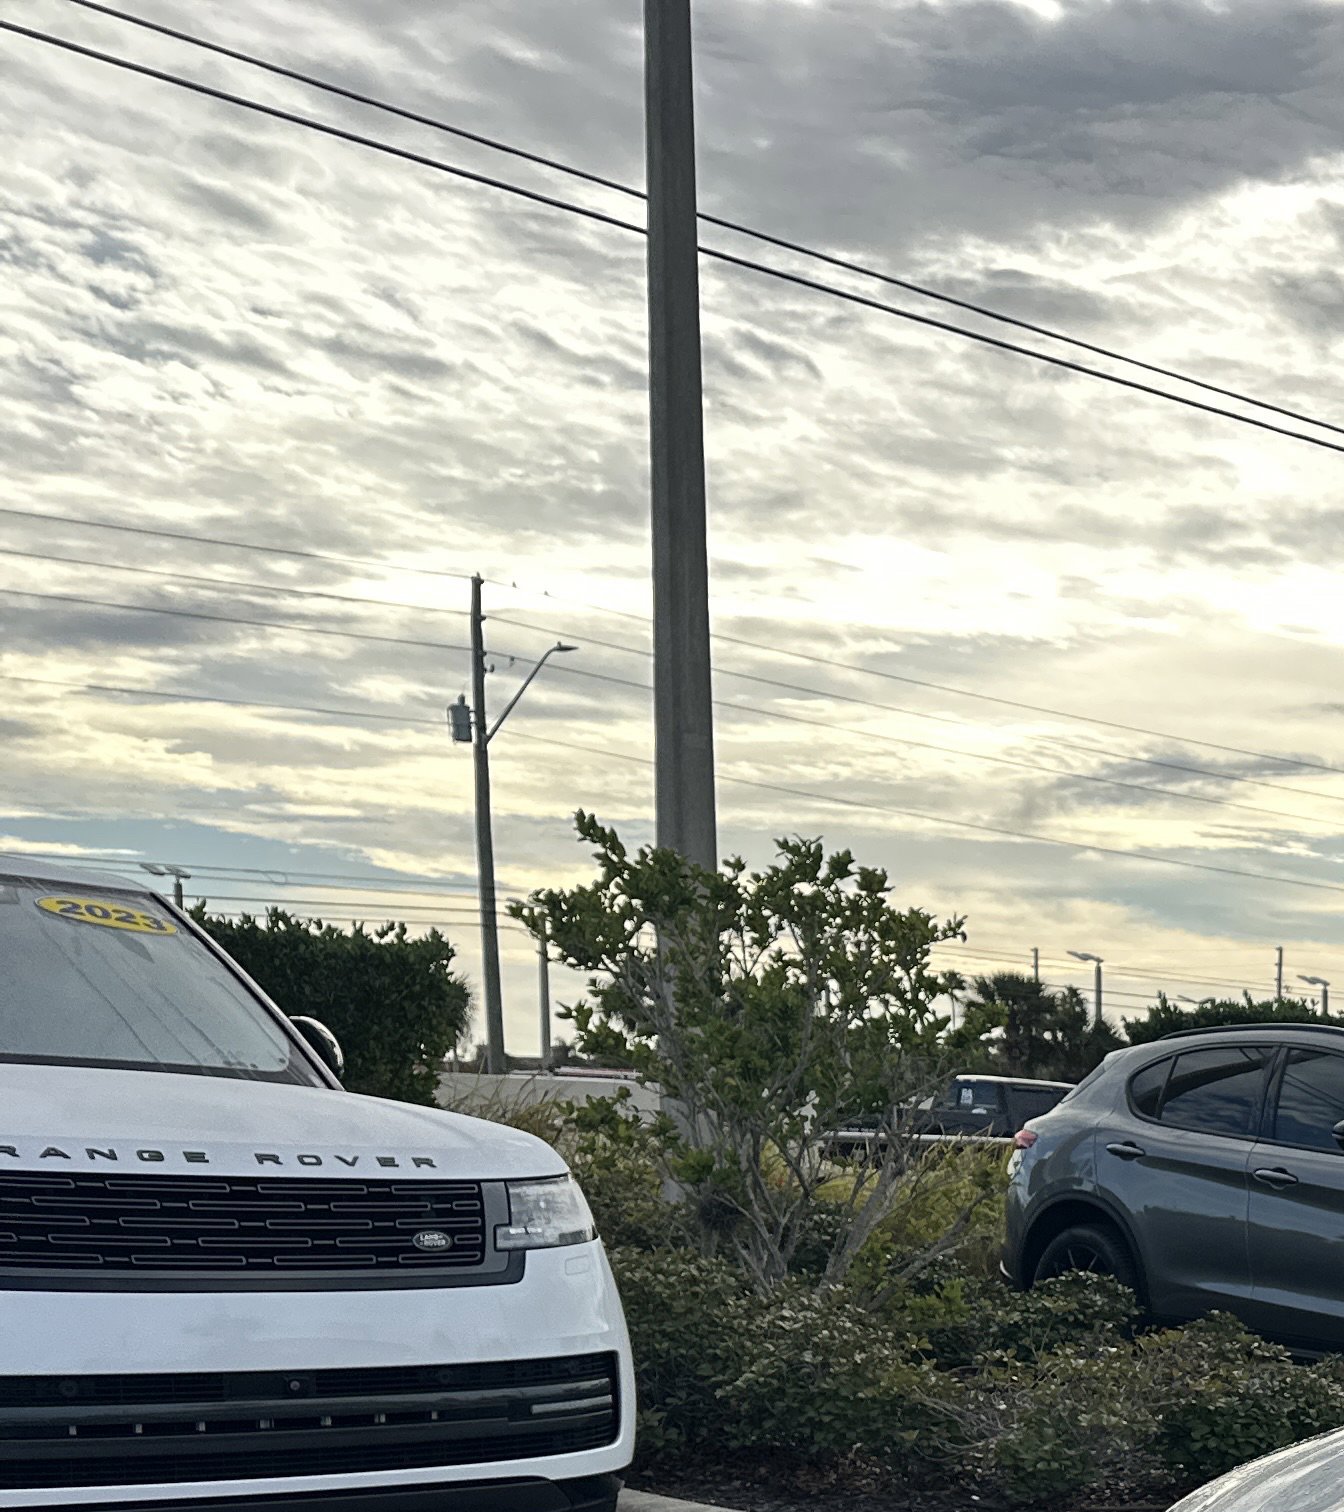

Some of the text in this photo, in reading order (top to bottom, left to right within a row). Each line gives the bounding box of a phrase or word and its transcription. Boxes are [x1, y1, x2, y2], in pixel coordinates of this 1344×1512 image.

[56, 900, 168, 931] 2023
[0, 1145, 438, 1168] RANGE ROVER
